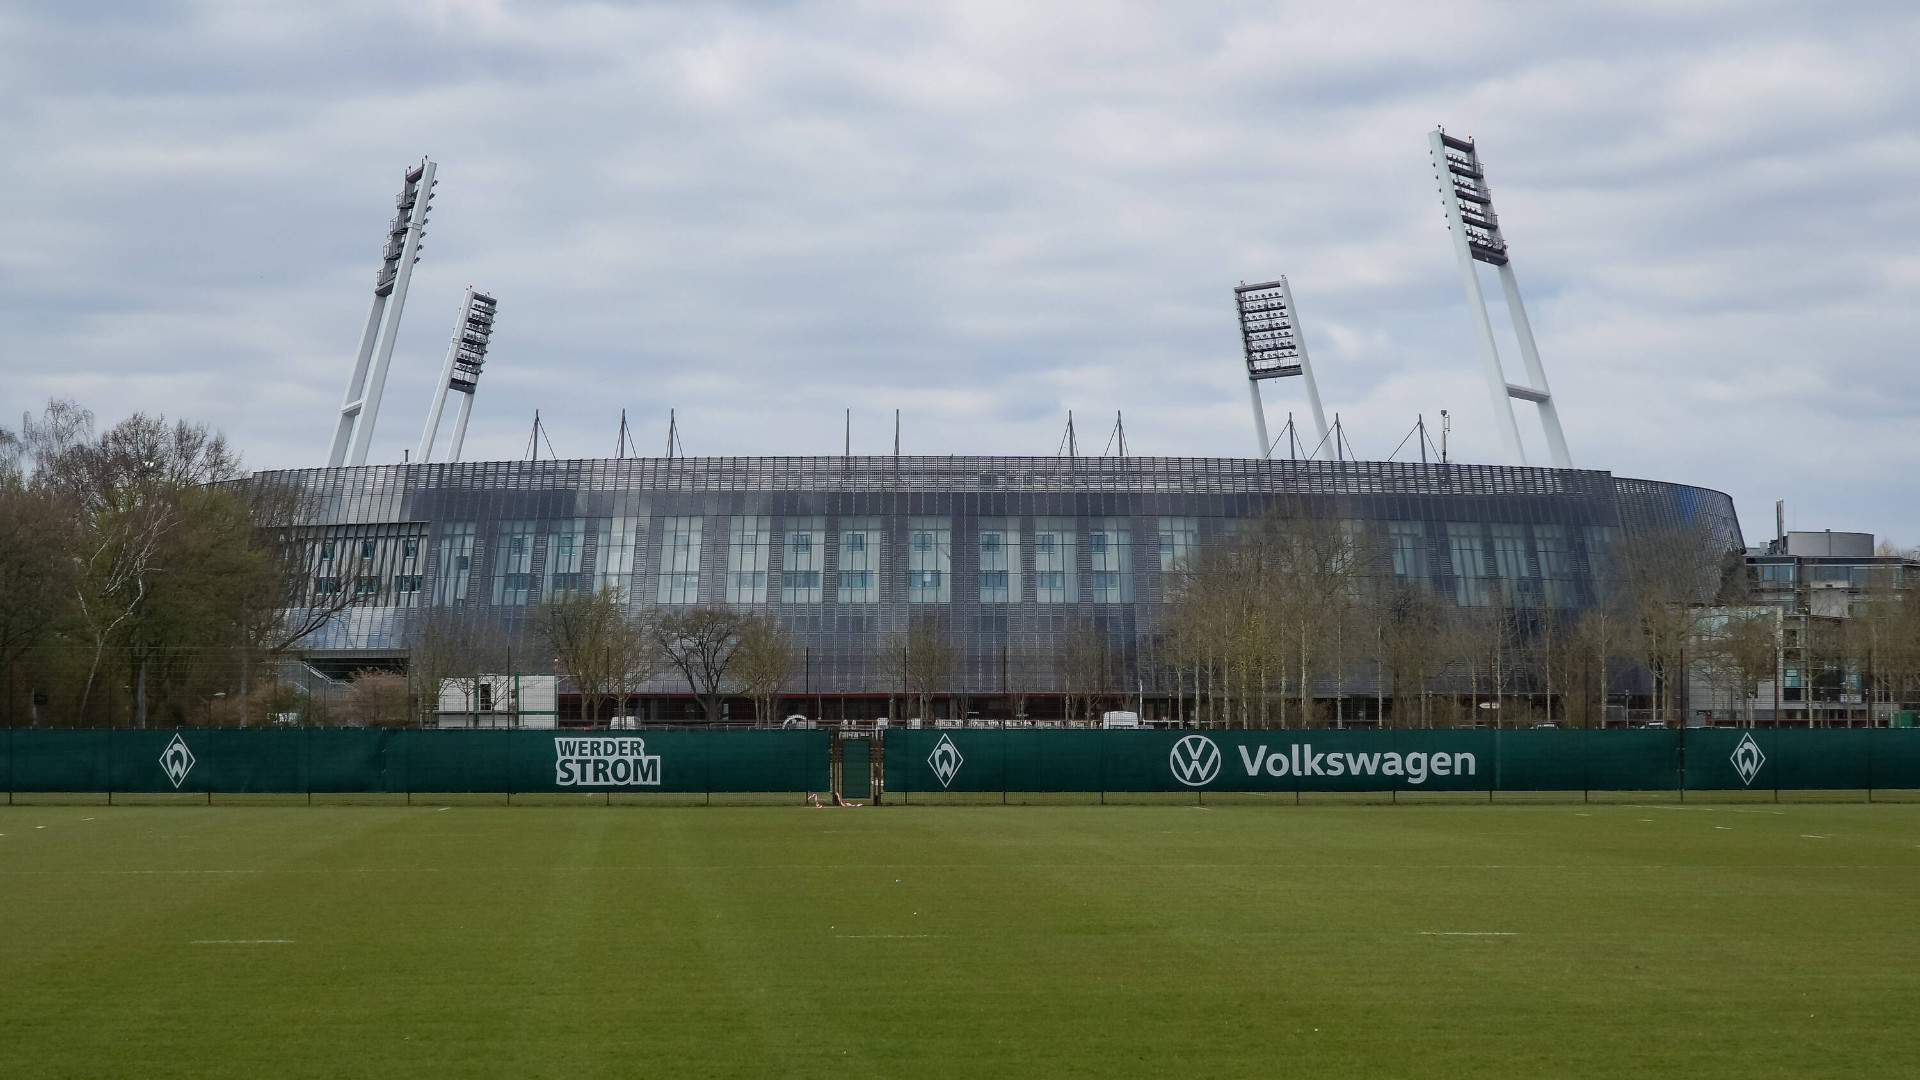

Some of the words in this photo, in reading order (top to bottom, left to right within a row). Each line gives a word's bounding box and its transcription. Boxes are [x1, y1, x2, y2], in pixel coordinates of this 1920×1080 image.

[558, 740, 642, 757] WERDER
[1172, 737, 1219, 783] VW
[1237, 743, 1477, 785] Volkswagen
[558, 758, 658, 783] STROM
